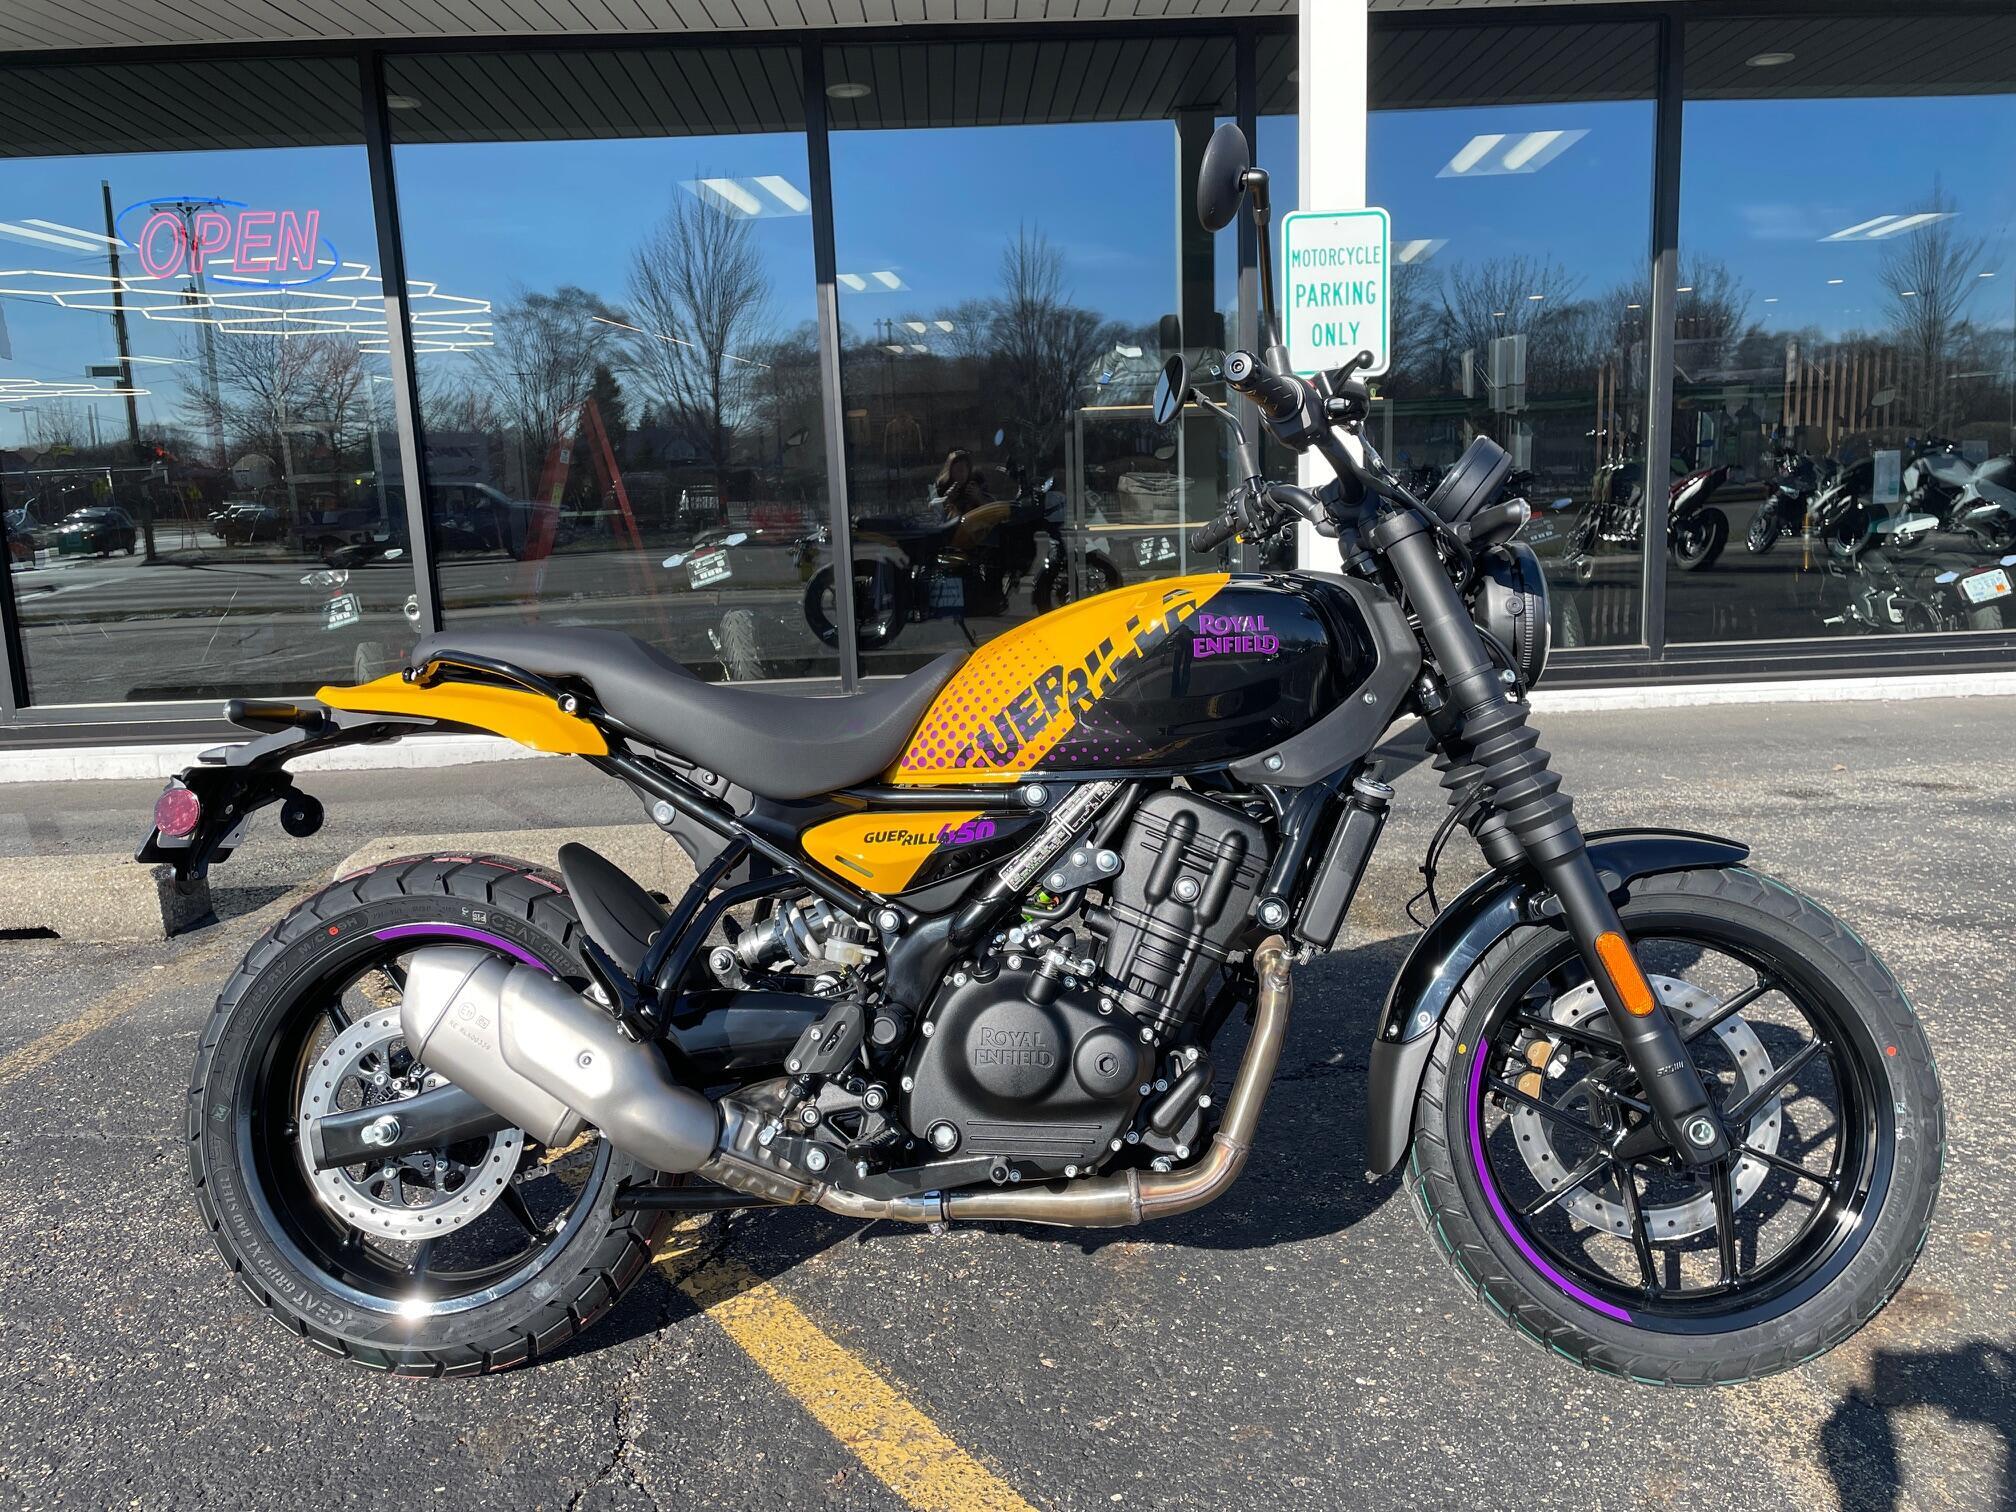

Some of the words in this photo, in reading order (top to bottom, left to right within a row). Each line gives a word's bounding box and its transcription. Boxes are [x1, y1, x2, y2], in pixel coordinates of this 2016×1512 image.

[139, 209, 320, 279] OPEN
[1292, 246, 1381, 268] MOTORCYCLE
[1296, 280, 1377, 308] PARKING
[1312, 321, 1361, 347] ONLY
[1198, 613, 1270, 636] ROYAL
[1193, 634, 1280, 658] ENFIELD
[936, 820, 996, 846] 450
[980, 1026, 1047, 1049] ROYAL
[974, 1048, 1056, 1070] ENFIELD
[293, 1290, 345, 1326] CEAT
